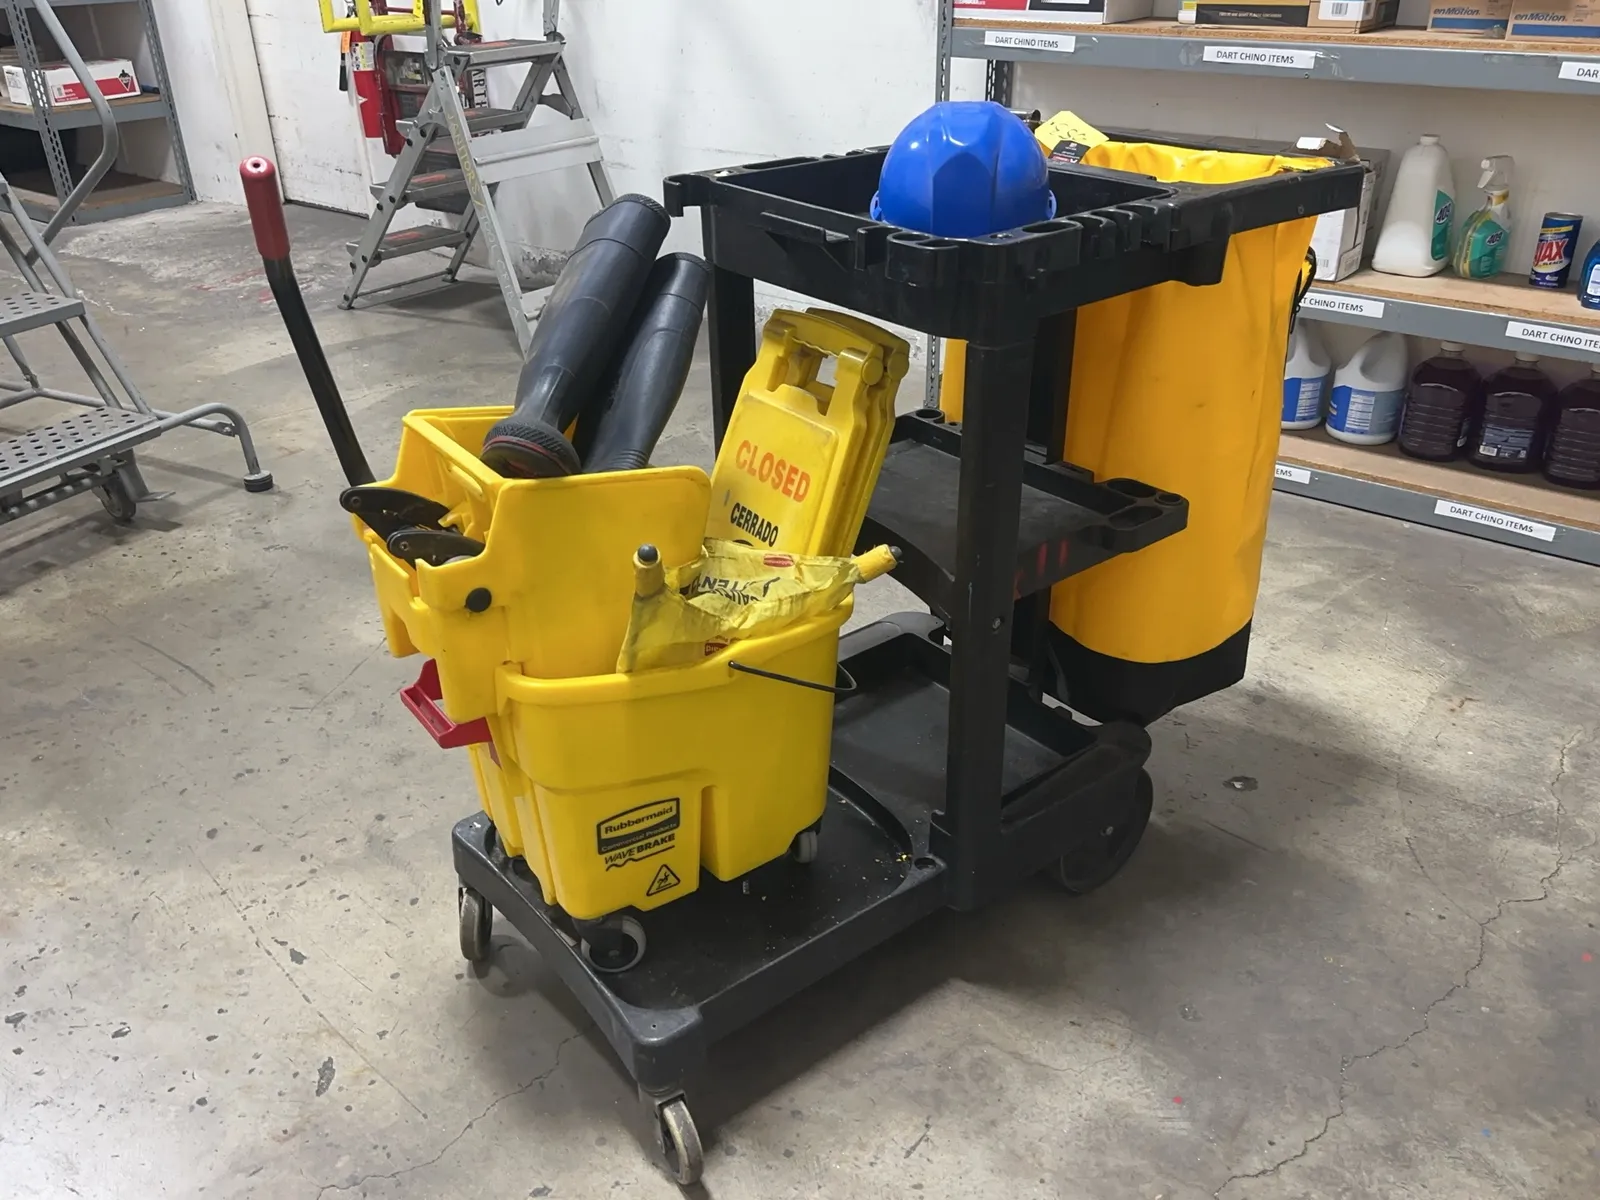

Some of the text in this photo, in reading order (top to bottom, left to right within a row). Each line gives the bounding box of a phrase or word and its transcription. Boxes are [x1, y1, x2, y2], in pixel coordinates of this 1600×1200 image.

[1433, 7, 1479, 16] enMotion
[1514, 12, 1565, 22] enMotion
[994, 36, 1059, 49] DART CHINO ITEMS
[1216, 50, 1294, 64] DART CHINO ITEMS
[1576, 67, 1600, 79] DAR
[1534, 238, 1568, 267] JAX
[1309, 298, 1336, 309] CHINO
[1337, 302, 1364, 313] ITEMS
[1521, 328, 1600, 349] DART CHINO ITE
[735, 439, 811, 503] CLOSED
[1275, 468, 1293, 478] EMS
[730, 502, 779, 548] CERRADO
[1450, 505, 1533, 534] DART CHINO ITEMS
[604, 806, 673, 835] Rubbermaid
